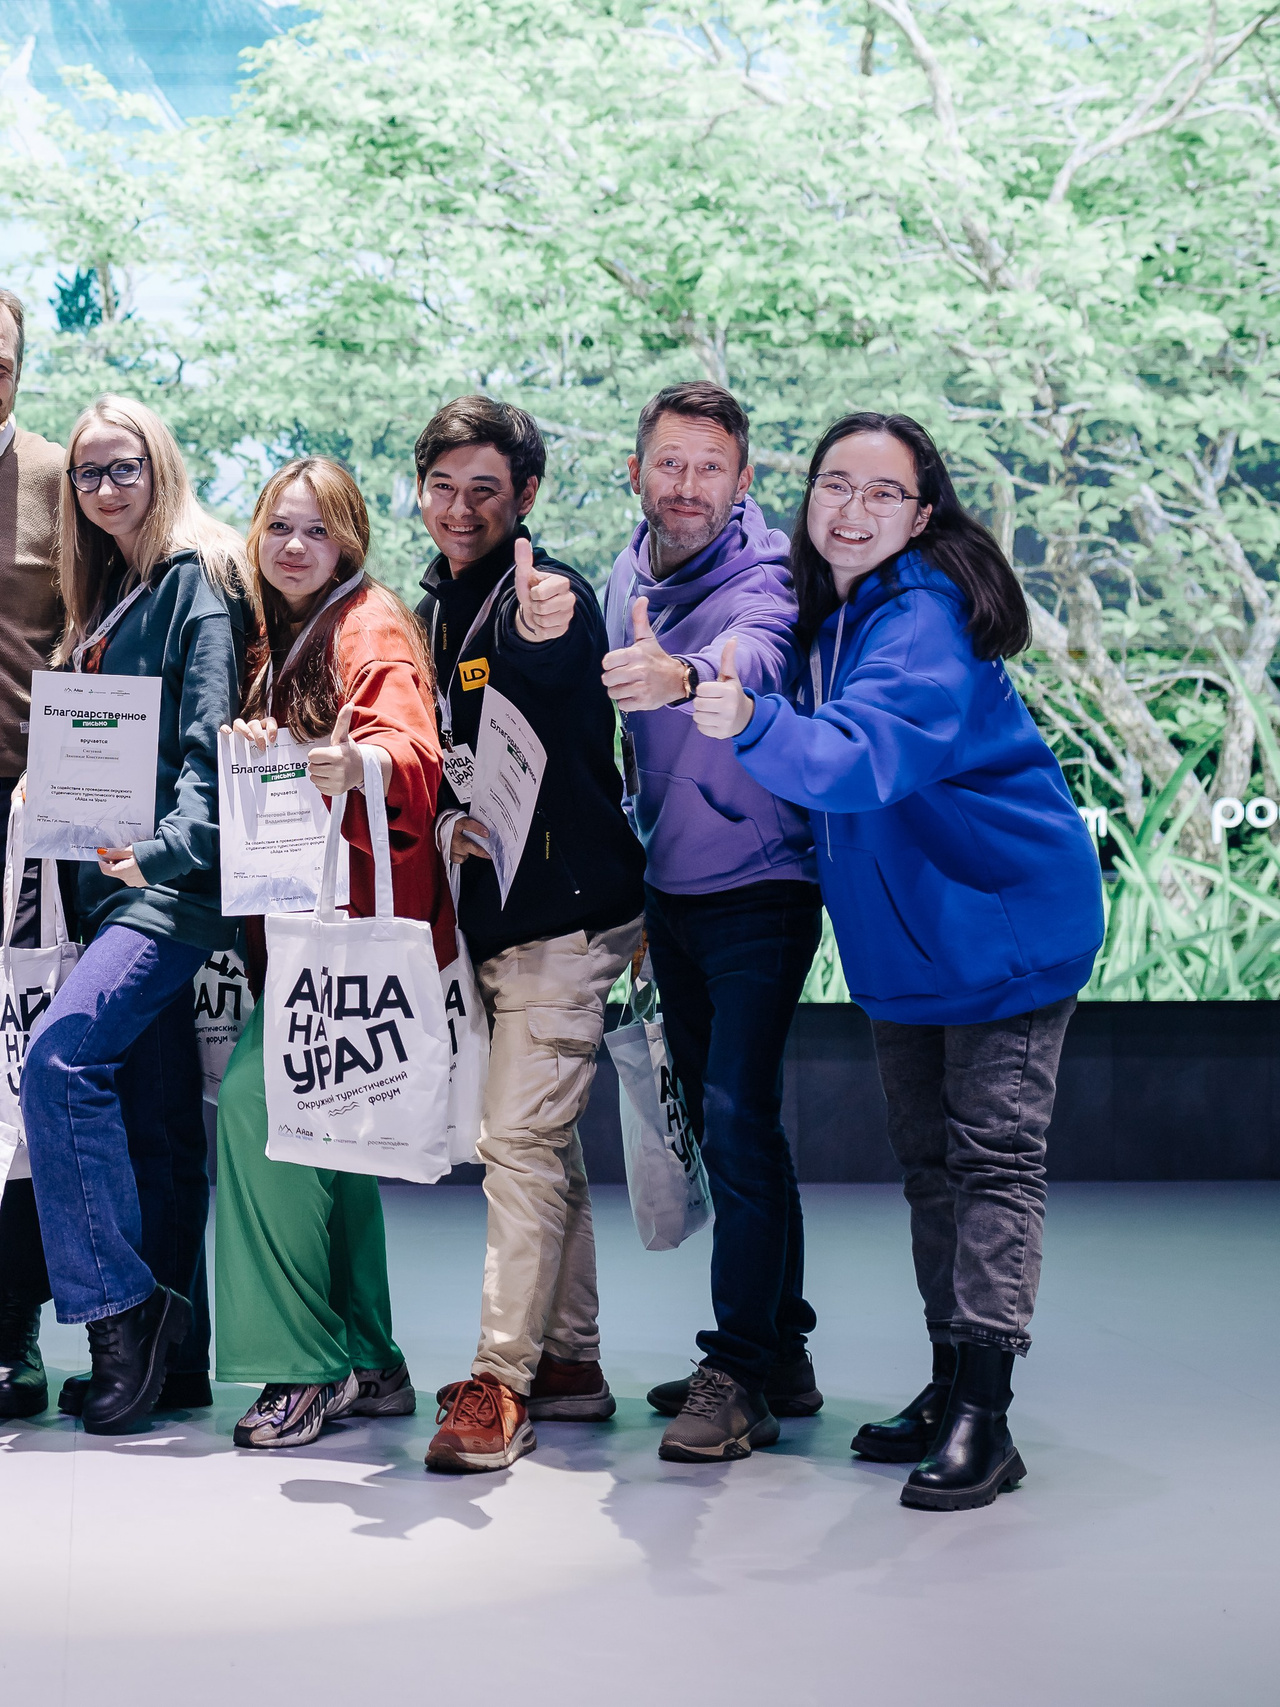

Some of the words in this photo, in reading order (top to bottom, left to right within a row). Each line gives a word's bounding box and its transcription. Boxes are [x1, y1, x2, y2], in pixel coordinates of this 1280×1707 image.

[44, 706, 146, 720] Благодарственное
[232, 761, 308, 774] Благодарстве
[444, 756, 474, 770] АЙДА
[448, 769, 459, 777] НА
[452, 765, 474, 786] УРАЛ
[195, 982, 242, 1020] АЛ
[284, 966, 414, 1020] АЙДА
[0, 986, 52, 1032] АЙ
[196, 1025, 238, 1033] ристический
[288, 1012, 327, 1046] НА
[283, 1020, 408, 1094] УРАЛ
[336, 1071, 408, 1102] туристический
[368, 1088, 401, 1105] форум
